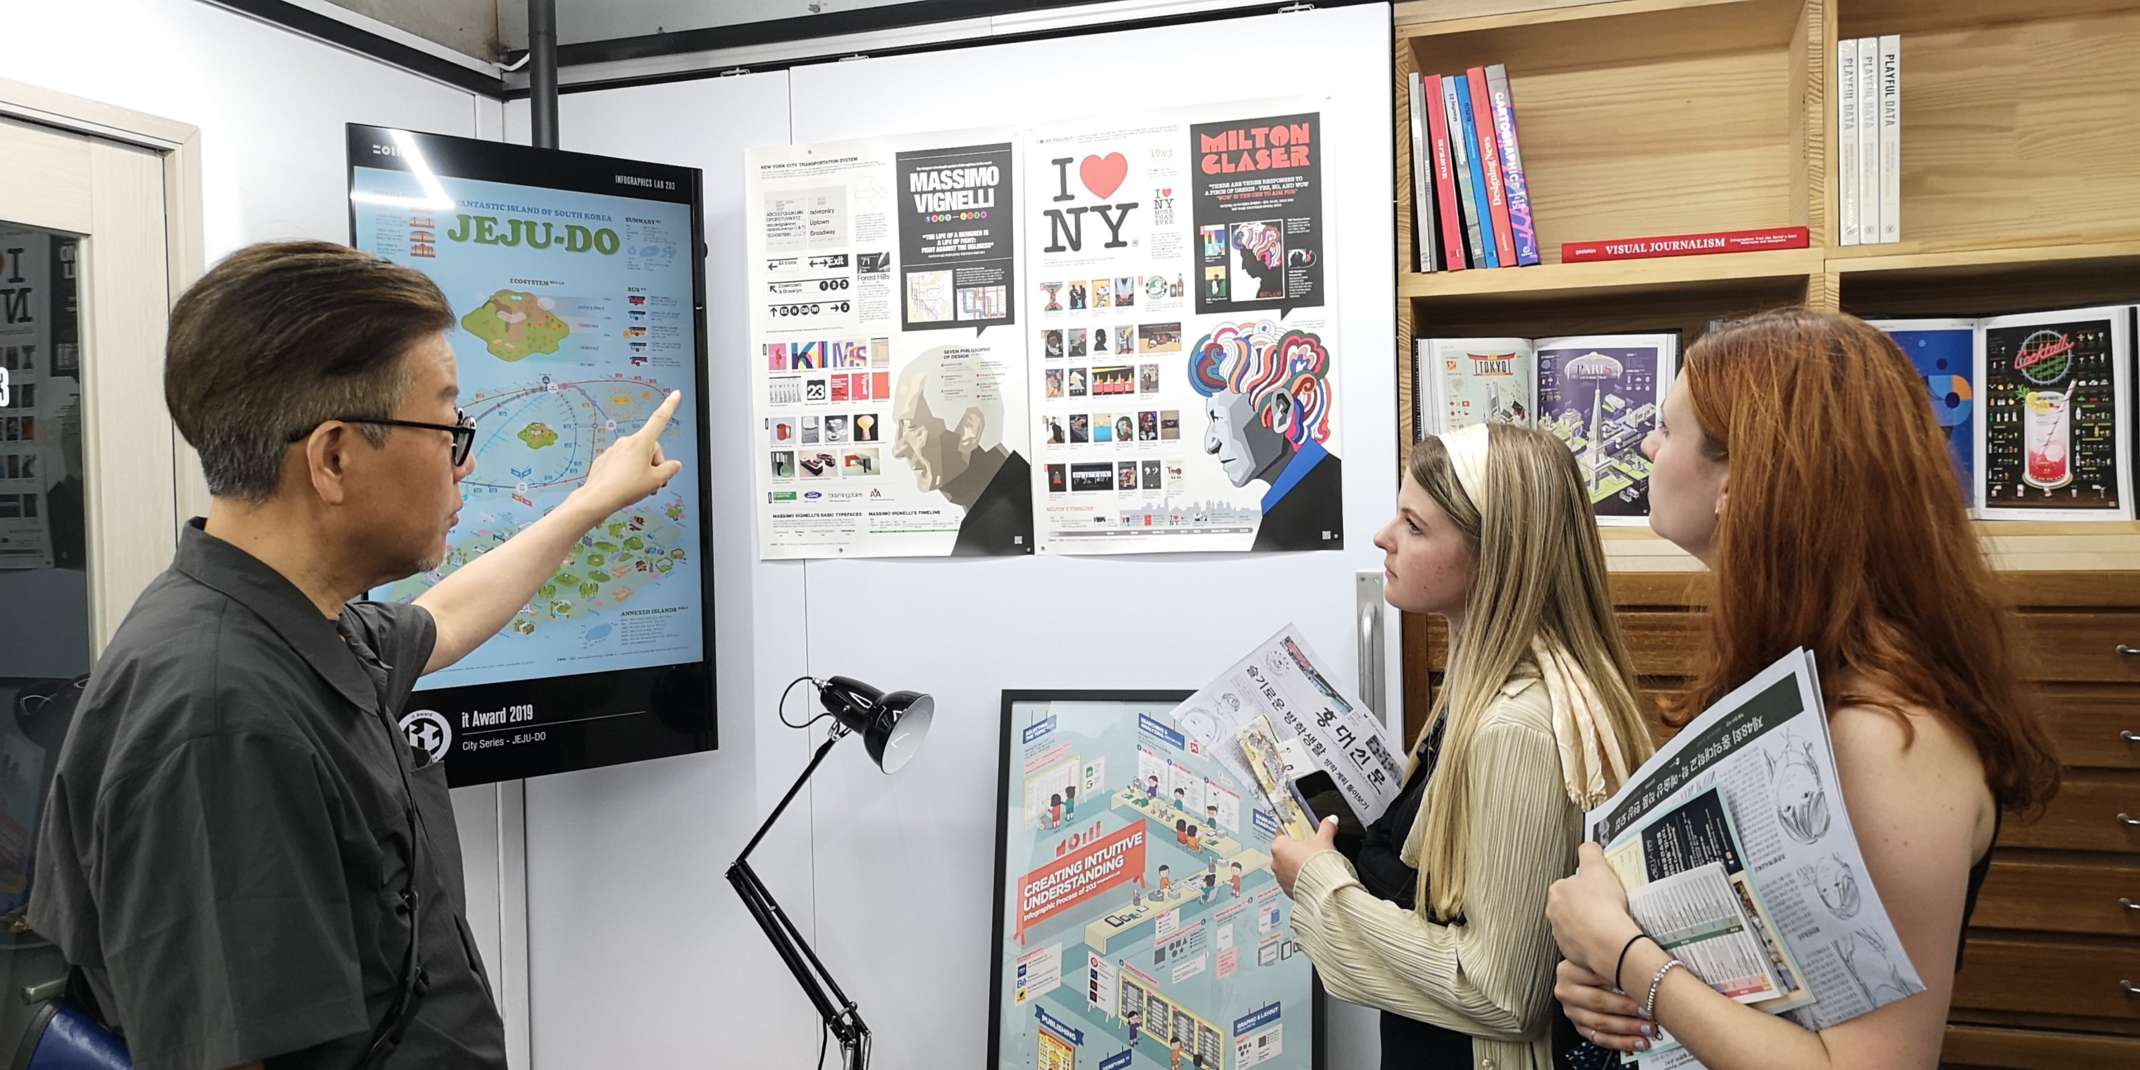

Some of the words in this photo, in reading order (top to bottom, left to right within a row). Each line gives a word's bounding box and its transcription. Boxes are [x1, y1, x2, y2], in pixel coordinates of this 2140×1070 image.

[1842, 58, 1854, 101] PLAYFUL
[1862, 56, 1873, 100] PLAYFUL
[1884, 54, 1895, 98] PLAYFUL
[1844, 104, 1854, 130] DATA
[1863, 102, 1874, 128] DATA
[1884, 100, 1895, 126] DATA
[1200, 122, 1310, 154] MILTON
[1484, 136, 1496, 162] News
[1494, 92, 1524, 190] CARTOGRAPHICS
[1201, 145, 1311, 176] GLASER
[614, 174, 652, 188] INFOGRAPHICS
[654, 179, 664, 190] LAB
[665, 181, 676, 191] 203
[909, 166, 1000, 192] MASSIMO
[1051, 156, 1076, 202] I
[1486, 160, 1502, 206] Designing
[507, 204, 540, 215] ISLAND
[554, 209, 583, 219] SOUTH
[584, 213, 613, 222] KOREA
[914, 188, 994, 214] VIGNELLI
[447, 214, 620, 256] JEJU-DO
[1042, 202, 1139, 254] NY
[1605, 242, 1647, 255] VISUAL
[1650, 237, 1726, 253] JOURNALISM
[2014, 334, 2076, 370] Cocktails
[1480, 360, 1508, 374] TOKYO
[807, 384, 825, 399] 23
[461, 711, 469, 729] it
[472, 707, 507, 727] Award
[509, 704, 534, 722] 2019
[1246, 664, 1285, 712] 슬기로운
[1284, 711, 1326, 757] 방학생활
[462, 741, 478, 752] City
[479, 738, 504, 750] Series
[512, 732, 546, 744] JEJU-DO
[1690, 734, 1731, 772] 홍익대학교
[1642, 791, 1656, 809] 작품
[1024, 860, 1084, 897] CREATING
[1084, 831, 1144, 868] INTUITIVE
[1023, 855, 1125, 912] UNDERSTANDING
[1040, 1014, 1077, 1041] PUBLISHING
